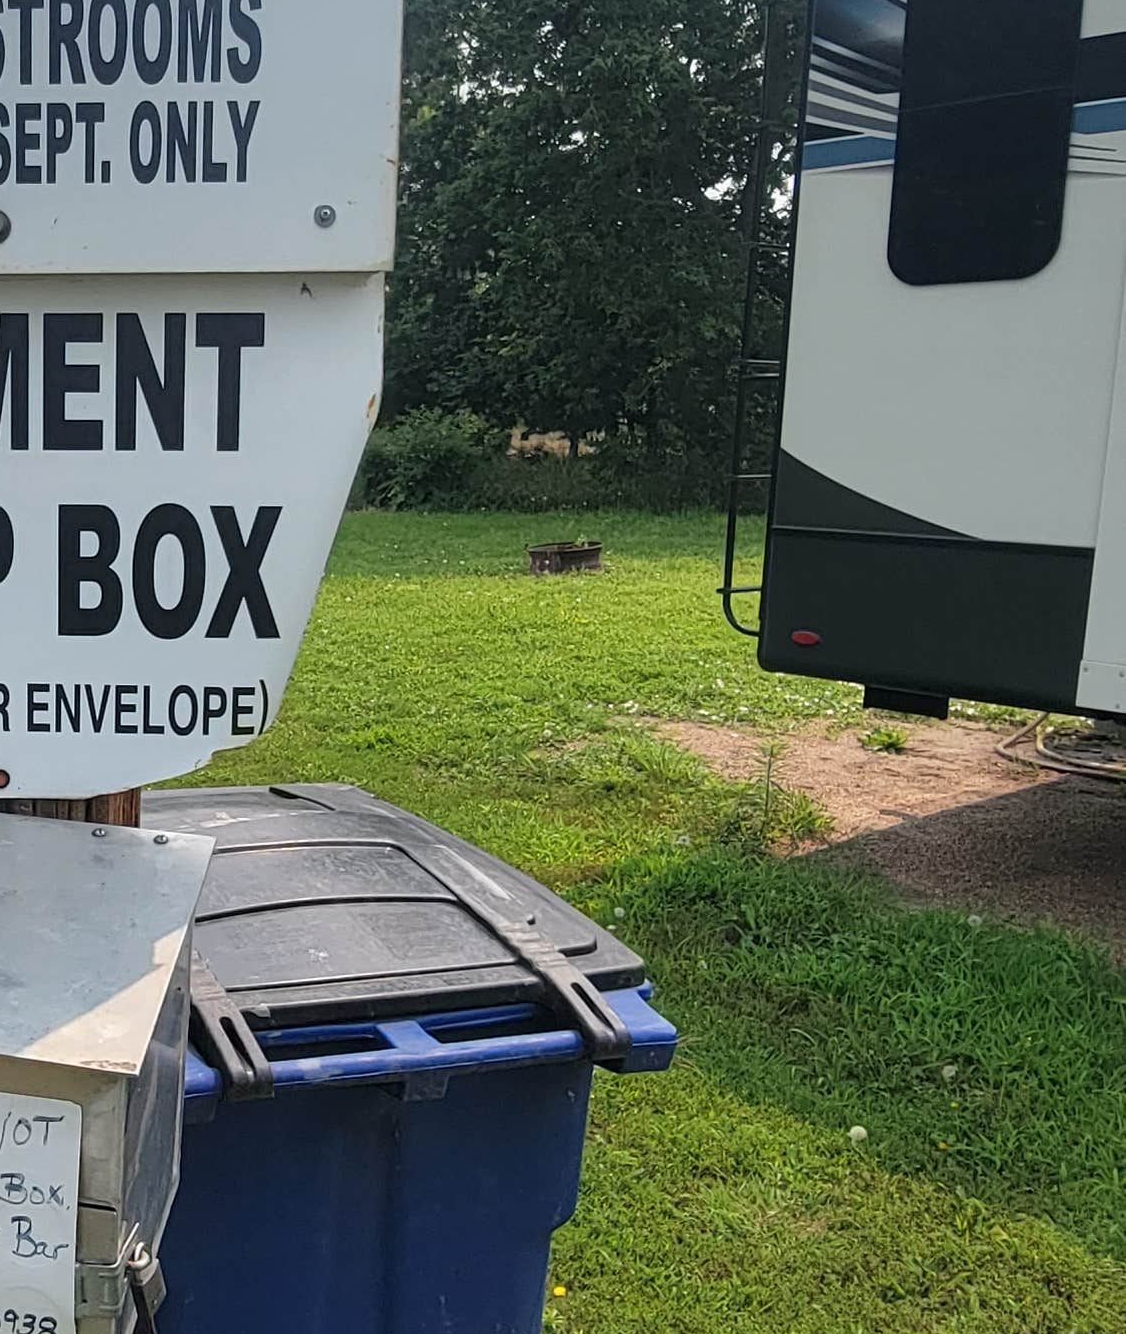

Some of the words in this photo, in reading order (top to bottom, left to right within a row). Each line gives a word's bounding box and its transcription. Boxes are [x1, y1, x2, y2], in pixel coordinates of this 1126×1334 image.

[129, 99, 261, 185] ONLY
[57, 502, 284, 640] BOX
[27, 678, 269, 737] ENVELOPE)
[10, 1215, 70, 1261] Bar
